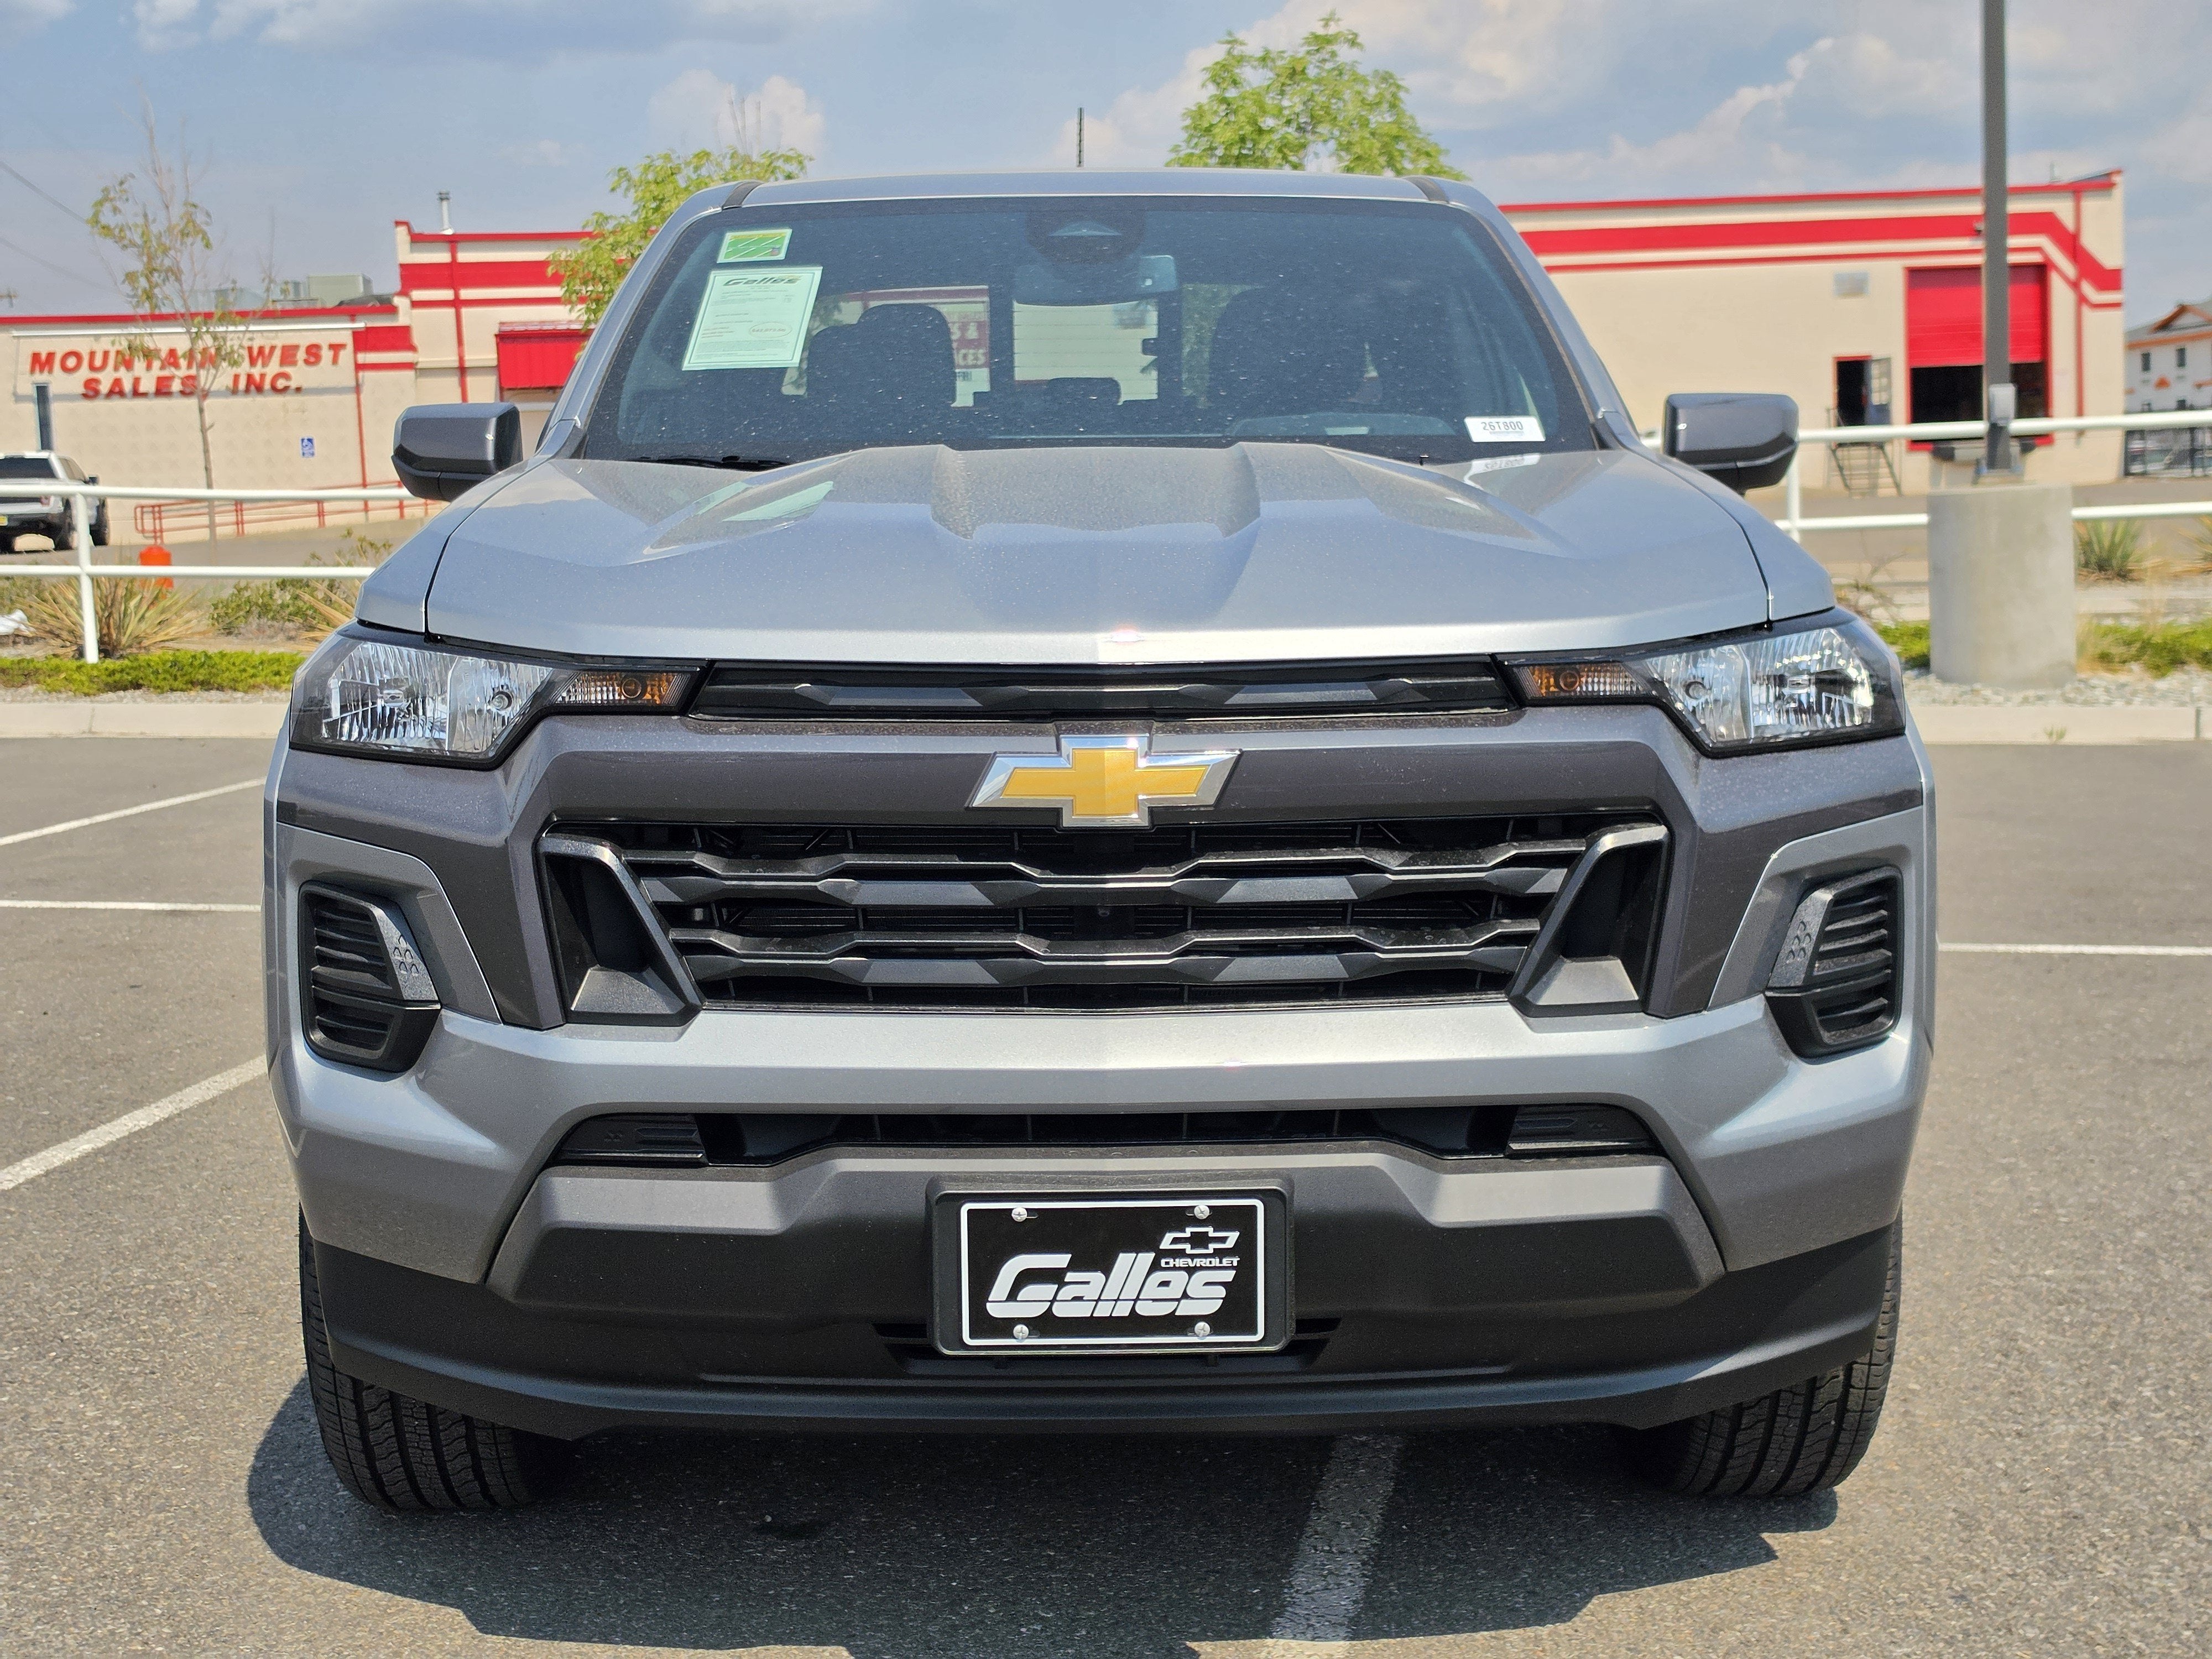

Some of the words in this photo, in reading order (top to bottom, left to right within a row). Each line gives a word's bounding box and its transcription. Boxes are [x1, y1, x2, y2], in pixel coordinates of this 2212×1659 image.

[30, 347, 218, 375] MOUNTAIN
[247, 343, 347, 368] WEST
[231, 371, 302, 395] INC.
[1481, 421, 1524, 431] 26T800
[1161, 1256, 1240, 1267] CHEVROLET
[986, 1252, 1237, 1318] Galles
